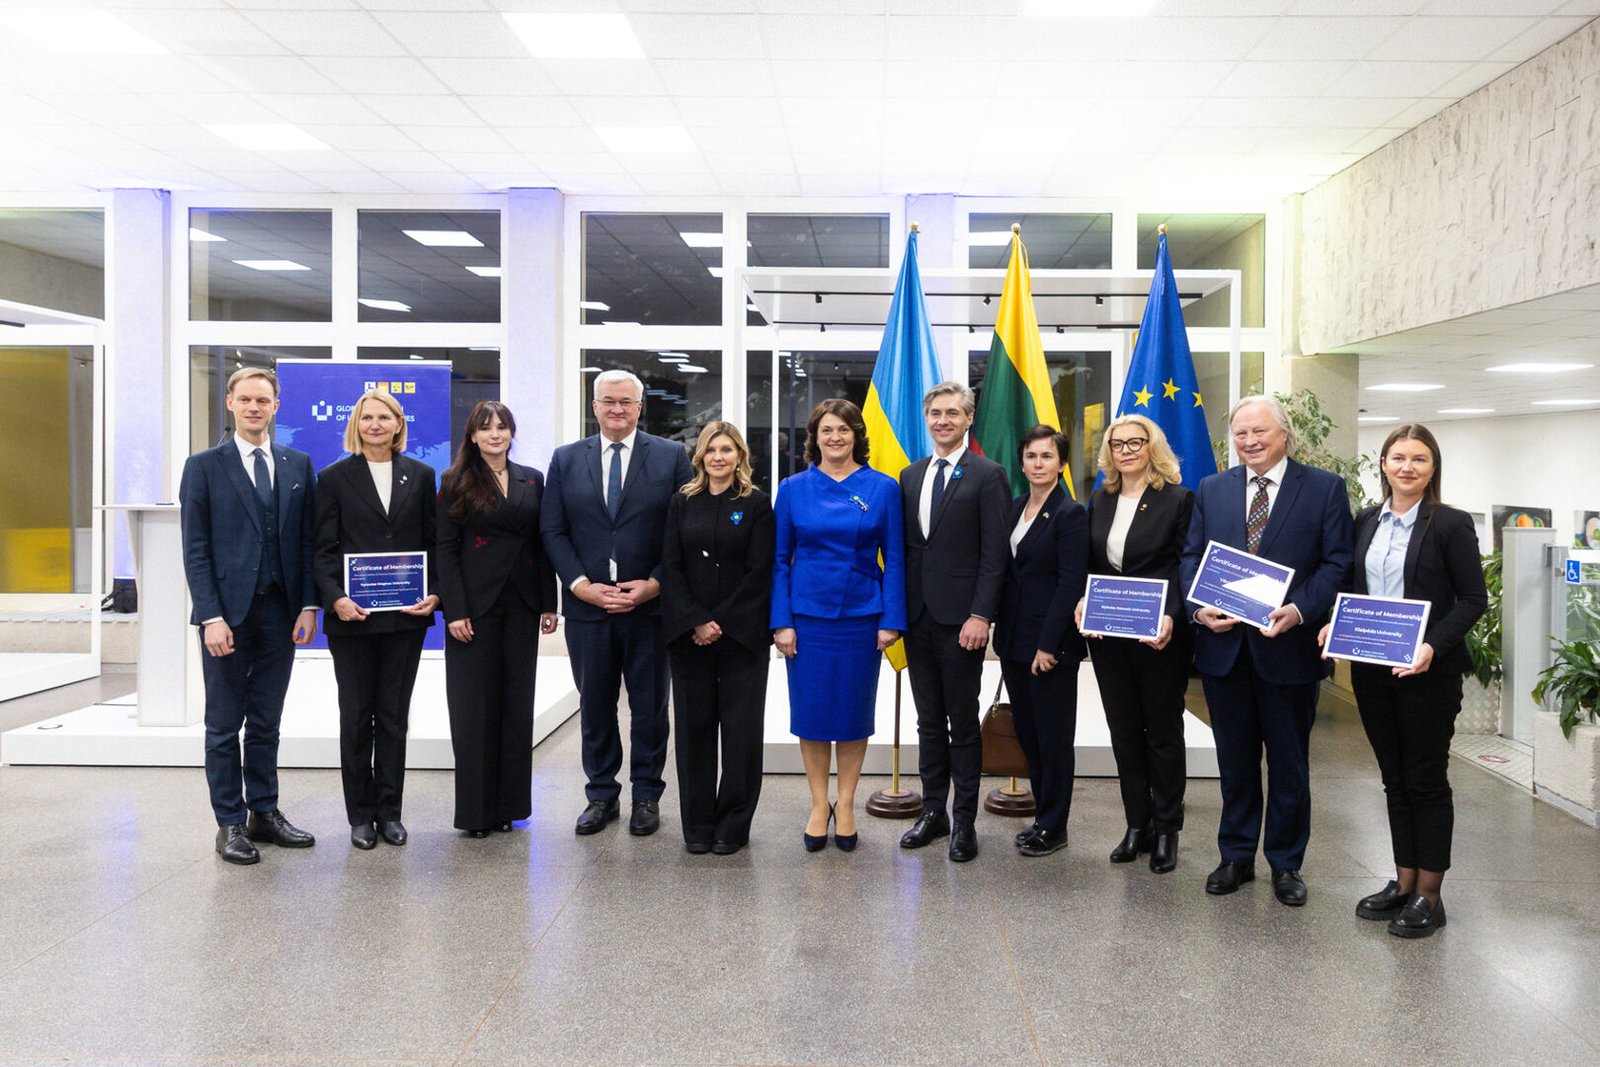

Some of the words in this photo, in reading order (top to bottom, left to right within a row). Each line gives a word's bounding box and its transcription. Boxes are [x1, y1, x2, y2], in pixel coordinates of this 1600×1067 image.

[1211, 556, 1241, 571] Certificate
[1129, 590, 1163, 598] Membership
[1342, 607, 1375, 616] Certificate
[1383, 611, 1423, 622] Membership
[1377, 629, 1403, 638] University
